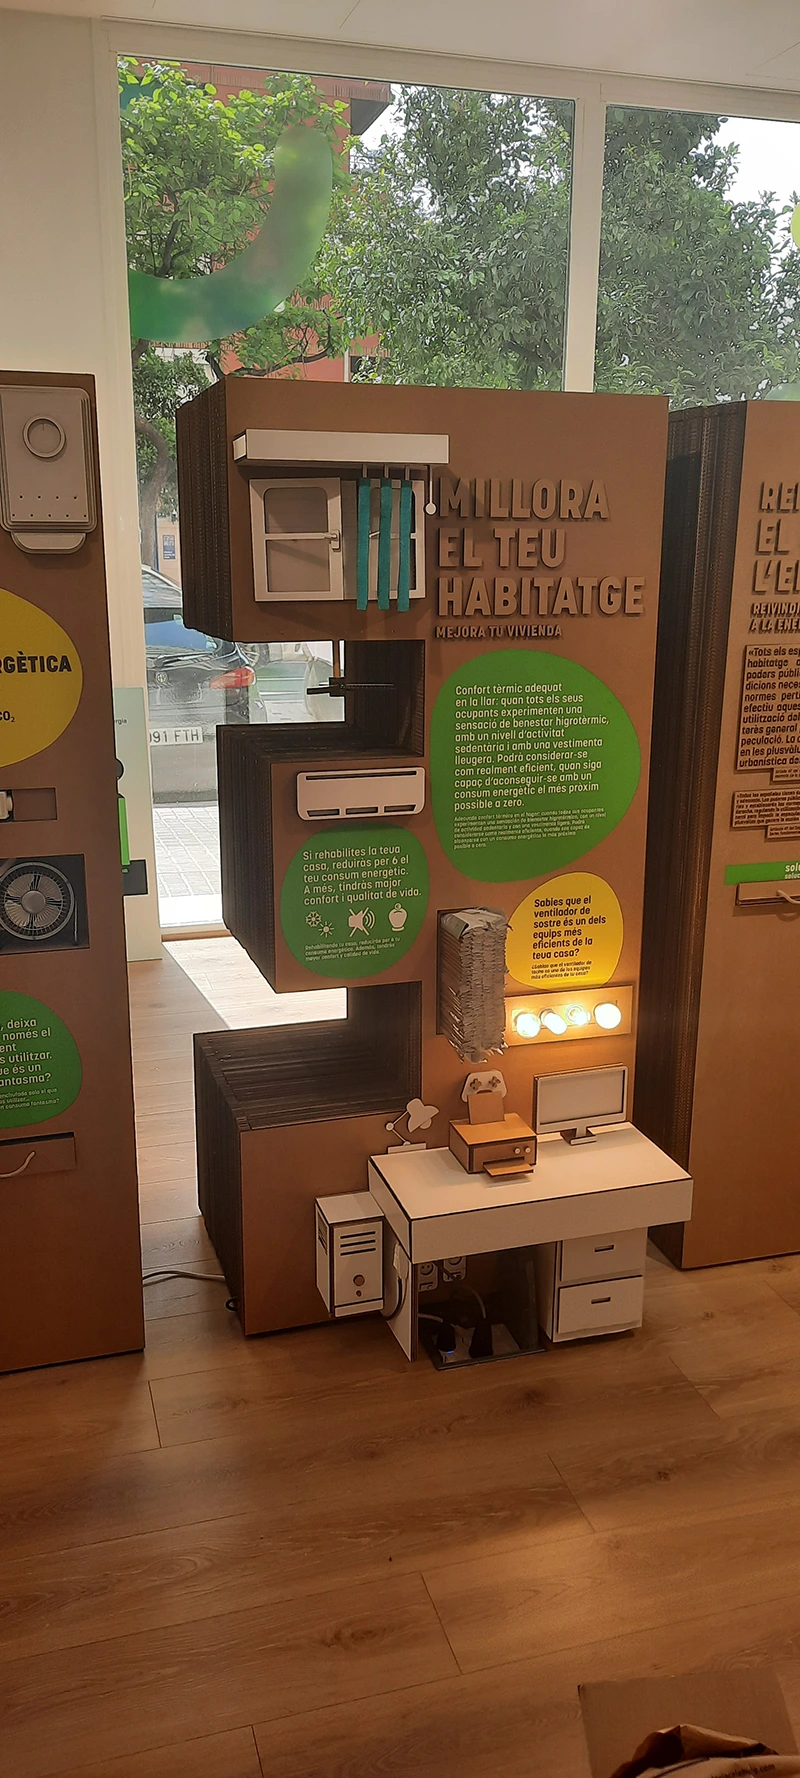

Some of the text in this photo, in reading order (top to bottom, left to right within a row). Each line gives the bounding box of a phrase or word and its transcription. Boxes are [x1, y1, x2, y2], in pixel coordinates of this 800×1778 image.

[438, 477, 609, 519] MILLORA
[756, 519, 790, 555] EL
[437, 528, 566, 568] EL TEU
[438, 576, 645, 616] HABITATGE
[435, 624, 563, 639] MEJORA TU VIVIENDA
[456, 682, 562, 695] Confort tèrmic adequat
[456, 693, 583, 708] en la llar: quan tots els seus
[456, 705, 582, 721] ocupants experimenten una
[455, 714, 609, 730] sensació de benestar higrotèrmic,
[150, 729, 199, 743] 91 FTH
[455, 727, 564, 742] amb un nivell d'activitat
[455, 737, 602, 753] sedentària i amb una vestimenta
[455, 750, 588, 766] lleugera. Podrà considerar-se
[455, 759, 601, 776] com realment eficient, quan siga
[455, 771, 592, 790] capaç d'aconseguir-se amb un
[454, 781, 599, 799] consum energètic el més pròxim
[454, 798, 524, 812] possible a zero.
[303, 846, 400, 861] Si rehabilites la teua
[303, 854, 409, 873] casa, reduiràs per 6 el
[304, 866, 408, 883] teu consum energètic.
[304, 877, 401, 895] A més, tindràs major
[304, 887, 421, 905] confort i qualitat de vida.
[534, 895, 591, 908] Sabies que el
[534, 906, 590, 918] ventilador de
[534, 919, 561, 928] sostre
[563, 917, 573, 926] és
[588, 915, 606, 924] dels
[533, 927, 582, 941] equips més
[533, 937, 593, 949] eficients de la
[533, 947, 580, 960] teua casa?
[7, 1017, 36, 1029] deixa
[3, 1027, 50, 1041] només el
[9, 1051, 52, 1063] utilitzar.
[12, 1063, 41, 1074] és un
